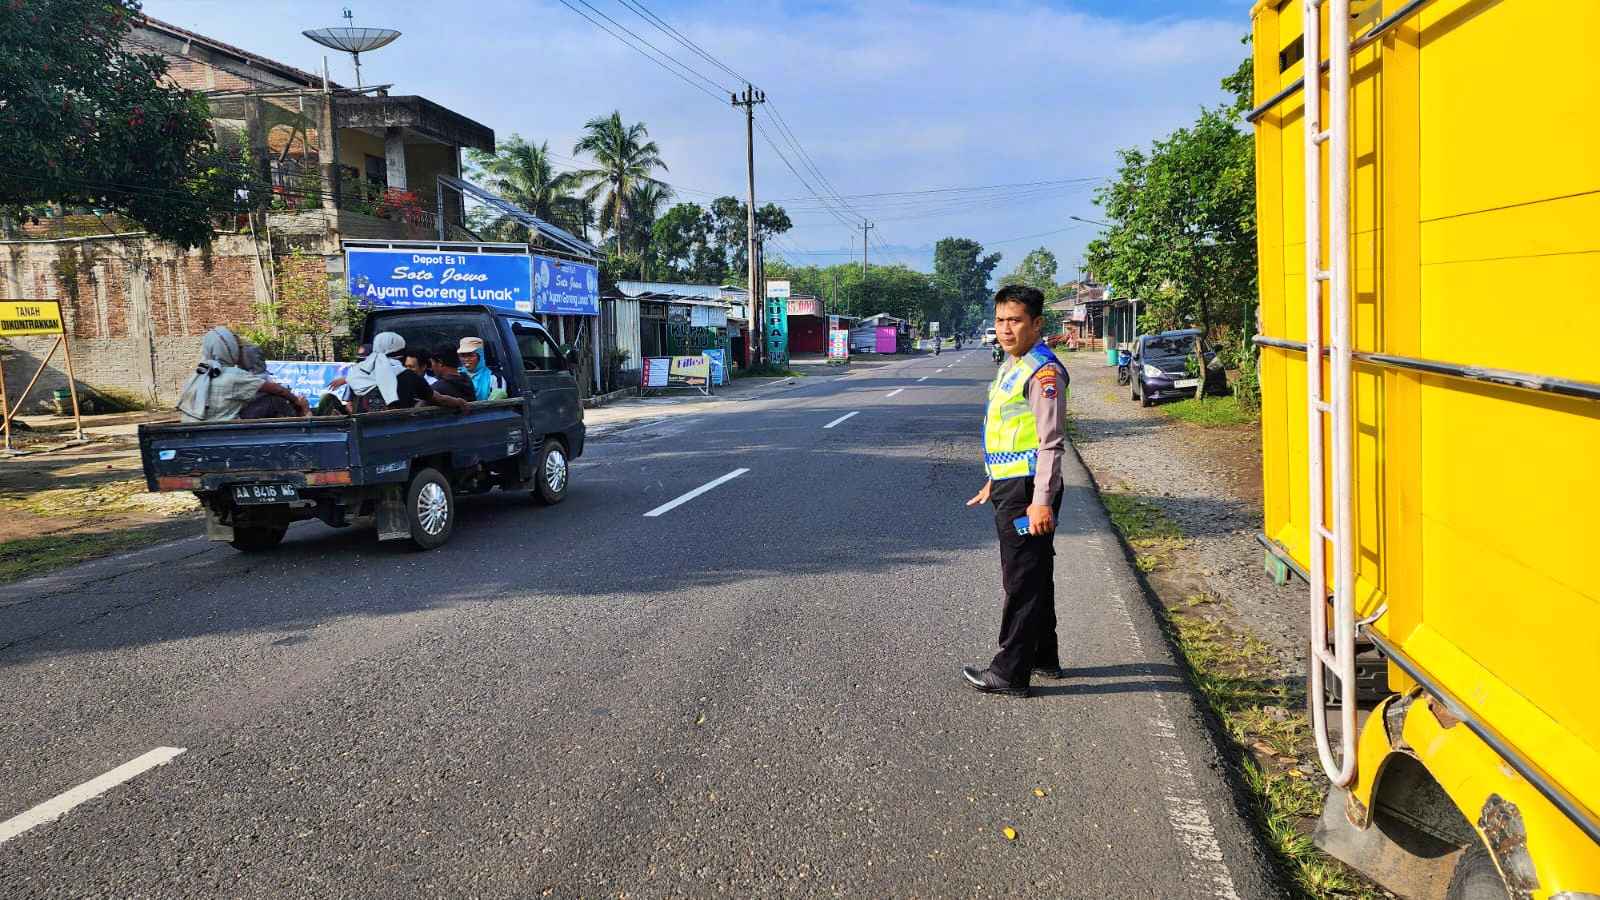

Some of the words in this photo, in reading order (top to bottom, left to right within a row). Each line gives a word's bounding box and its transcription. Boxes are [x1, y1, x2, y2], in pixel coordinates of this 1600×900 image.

[413, 255, 442, 266] Depot
[445, 256, 455, 265] Es
[458, 256, 465, 265] 11
[392, 266, 434, 280] Soto
[439, 267, 488, 284] Jowo
[358, 284, 408, 300] "Ayam
[412, 285, 466, 302] Goreng
[470, 287, 520, 301] Lunak"
[15, 306, 41, 317] TANAH
[0, 319, 60, 330] DIKONTRAKKAN
[236, 486, 250, 498] AA
[252, 485, 277, 497] 8416
